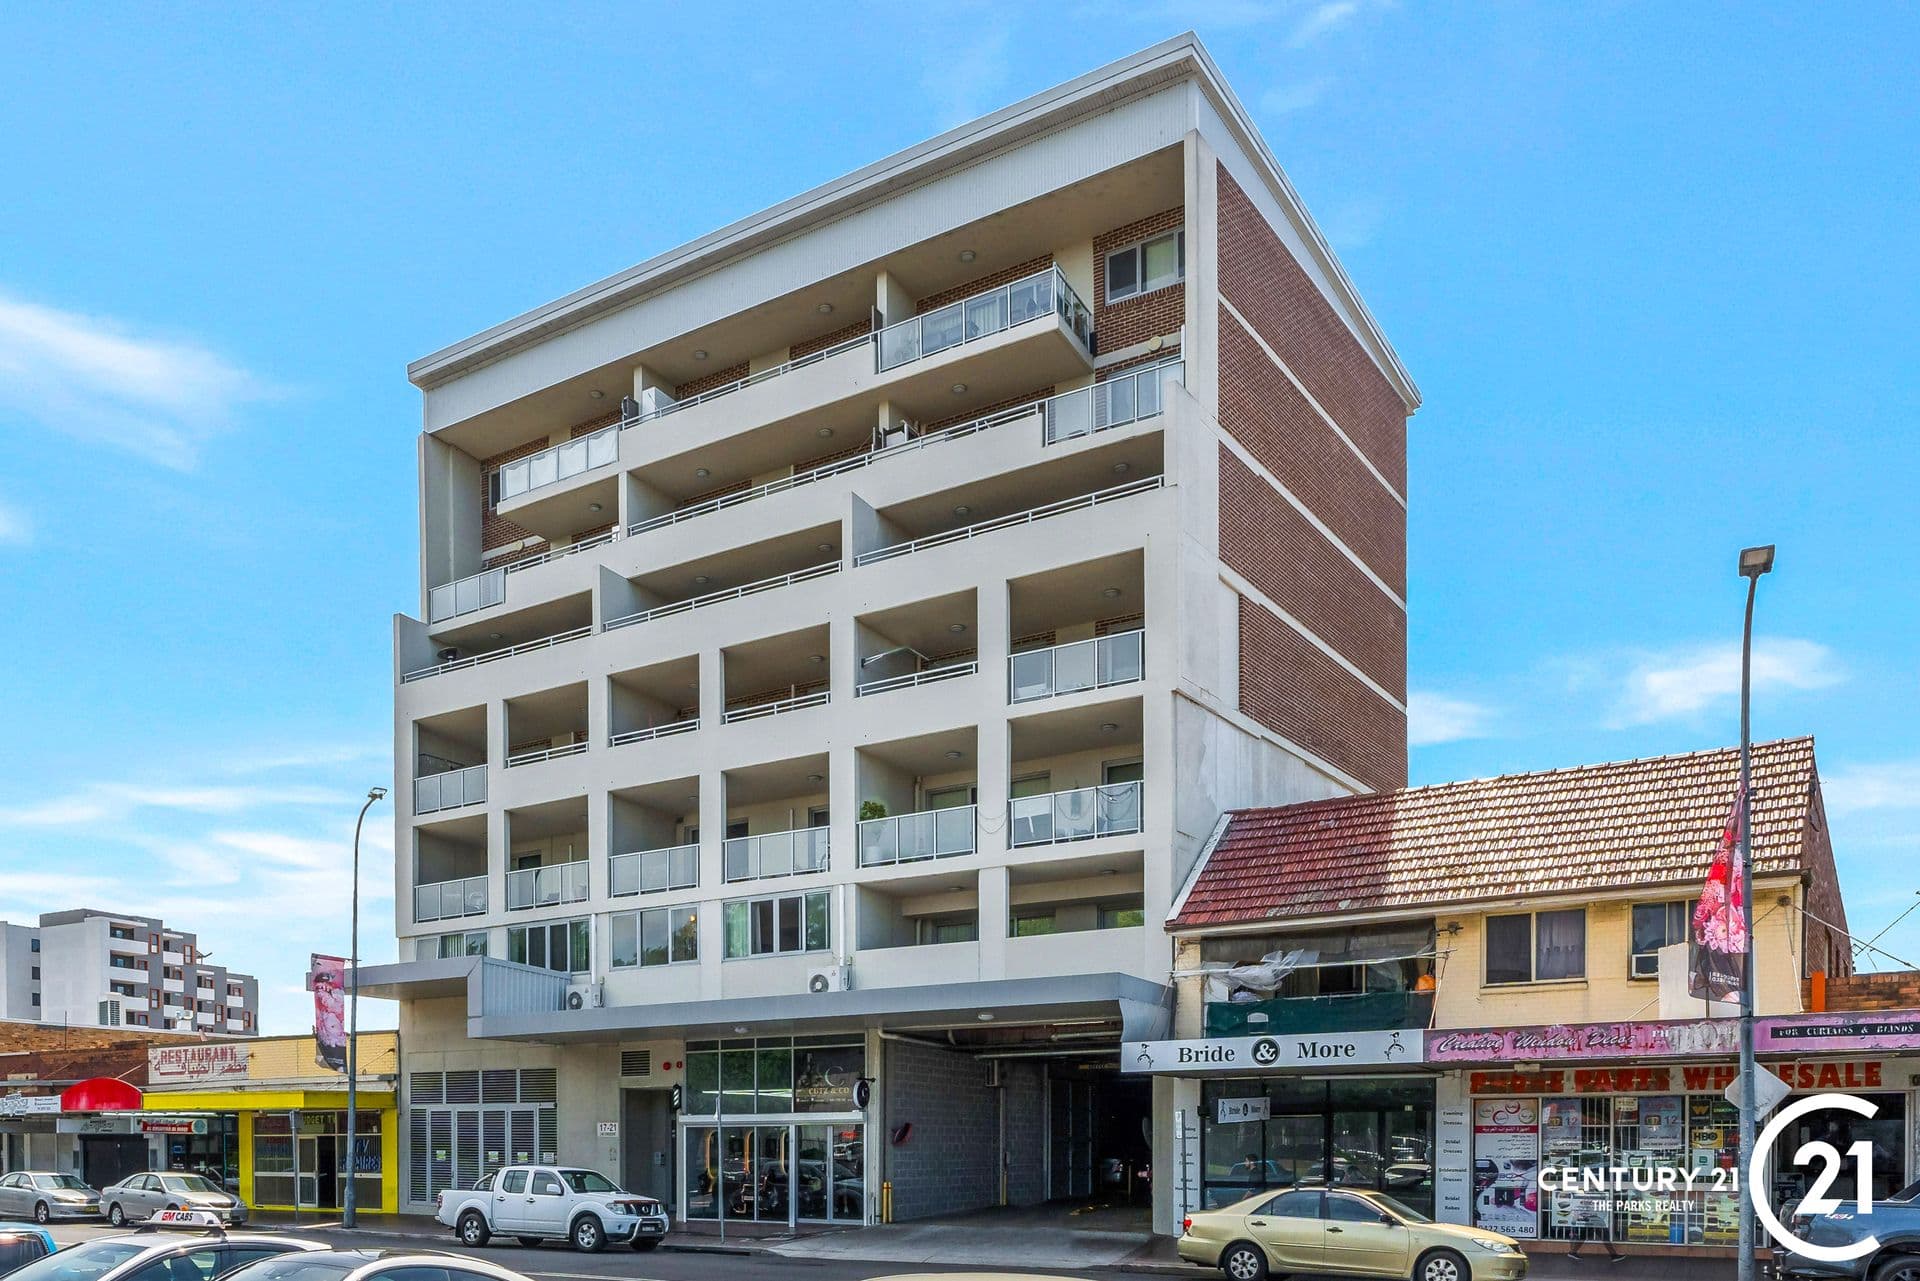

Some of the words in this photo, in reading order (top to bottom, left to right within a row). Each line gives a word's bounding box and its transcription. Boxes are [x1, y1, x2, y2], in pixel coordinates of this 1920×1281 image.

[1806, 1025, 1854, 1037] CURTAINS
[1439, 1032, 1504, 1054] Creative
[1515, 1032, 1578, 1048] Window
[1586, 1030, 1636, 1048] Decor
[160, 1046, 237, 1064] RESTAURANT
[1178, 1045, 1236, 1064] Bride
[1255, 1041, 1277, 1062] &
[1297, 1040, 1356, 1060] More
[1682, 1062, 1882, 1090] WHESALE
[1693, 1131, 1718, 1141] HBO
[176, 1212, 193, 1221] CABS
[1501, 1225, 1516, 1233] 565
[1518, 1226, 1535, 1234] 480
